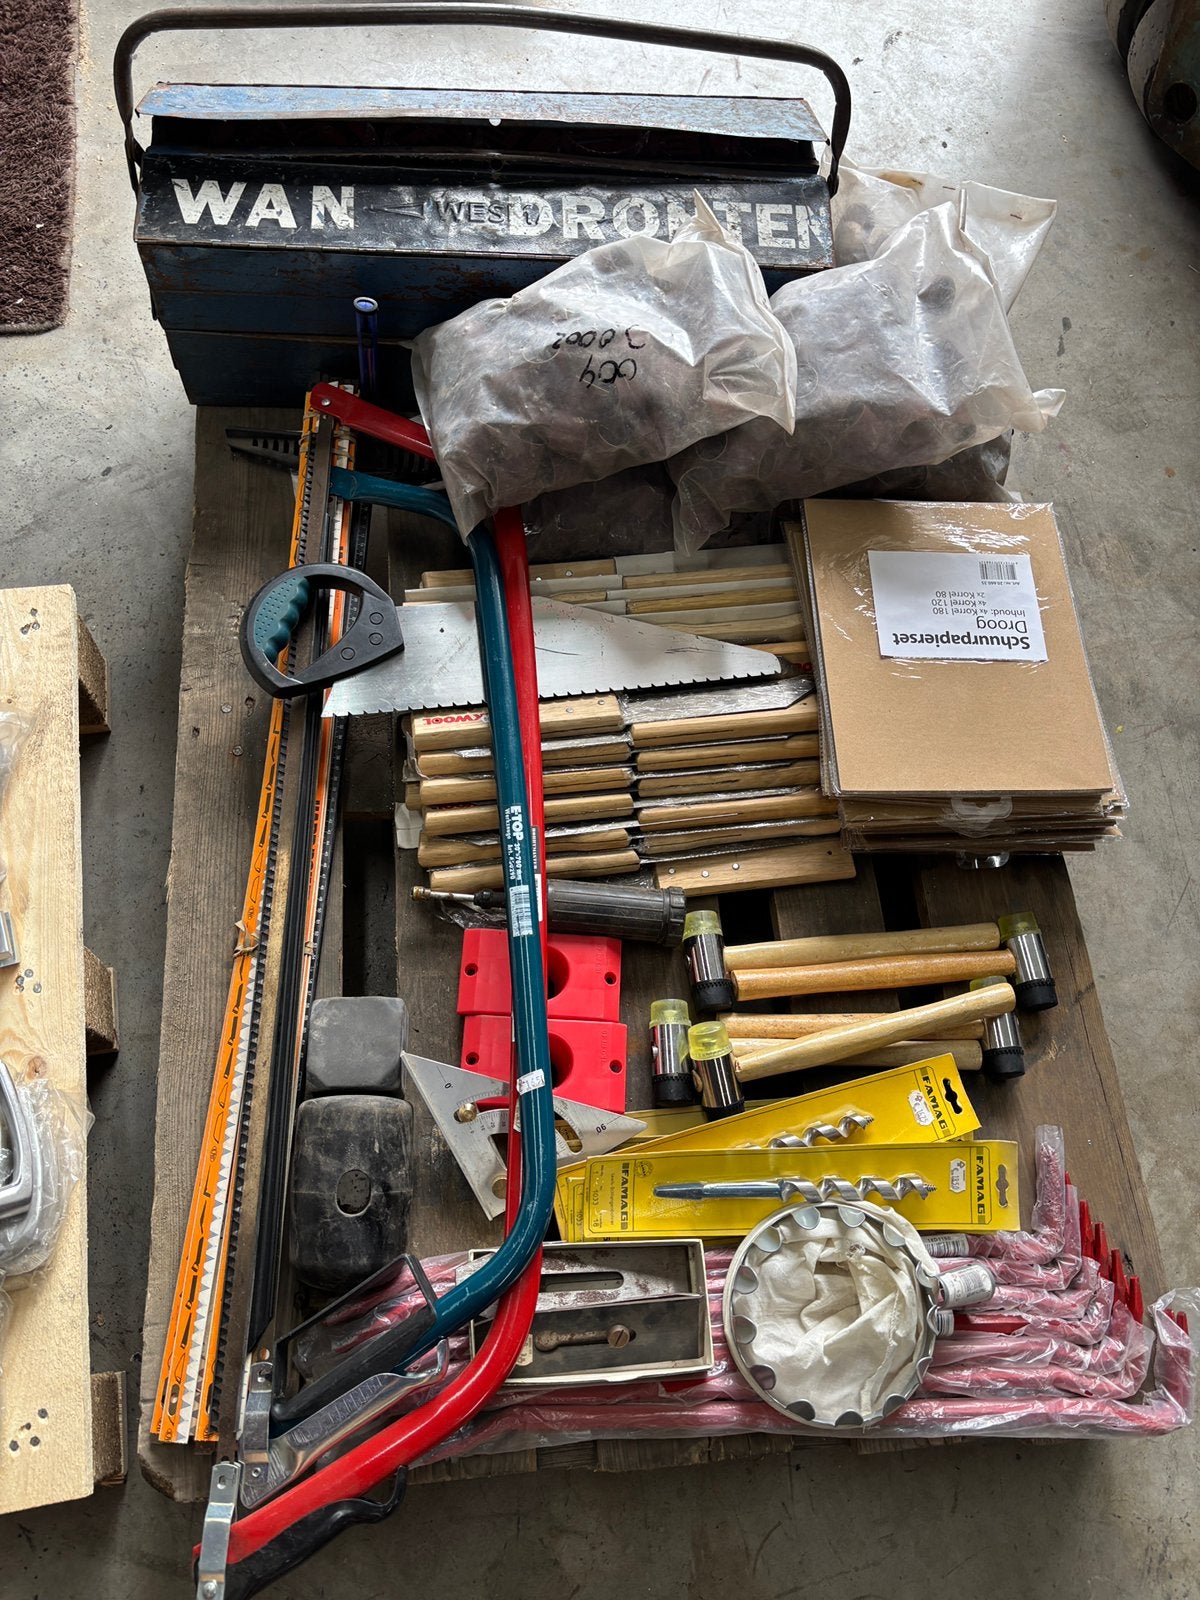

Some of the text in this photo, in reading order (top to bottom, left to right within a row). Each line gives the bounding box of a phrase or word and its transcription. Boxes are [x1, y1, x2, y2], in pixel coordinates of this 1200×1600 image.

[171, 178, 354, 230] WAN
[935, 590, 947, 598] 80
[948, 590, 976, 599] Korrel
[931, 598, 947, 606] 120
[950, 598, 977, 607] Korrel
[932, 607, 949, 615] 180
[951, 607, 979, 616] Korrel
[991, 609, 1026, 617] Inhoud:
[976, 615, 1028, 634] Droog
[892, 630, 1031, 650] Schuurpapierset
[510, 805, 524, 841] E-TOP
[922, 1075, 948, 1130] FAMAG
[976, 1155, 986, 1214] FAMAG
[620, 1169, 630, 1224] FAMAG
